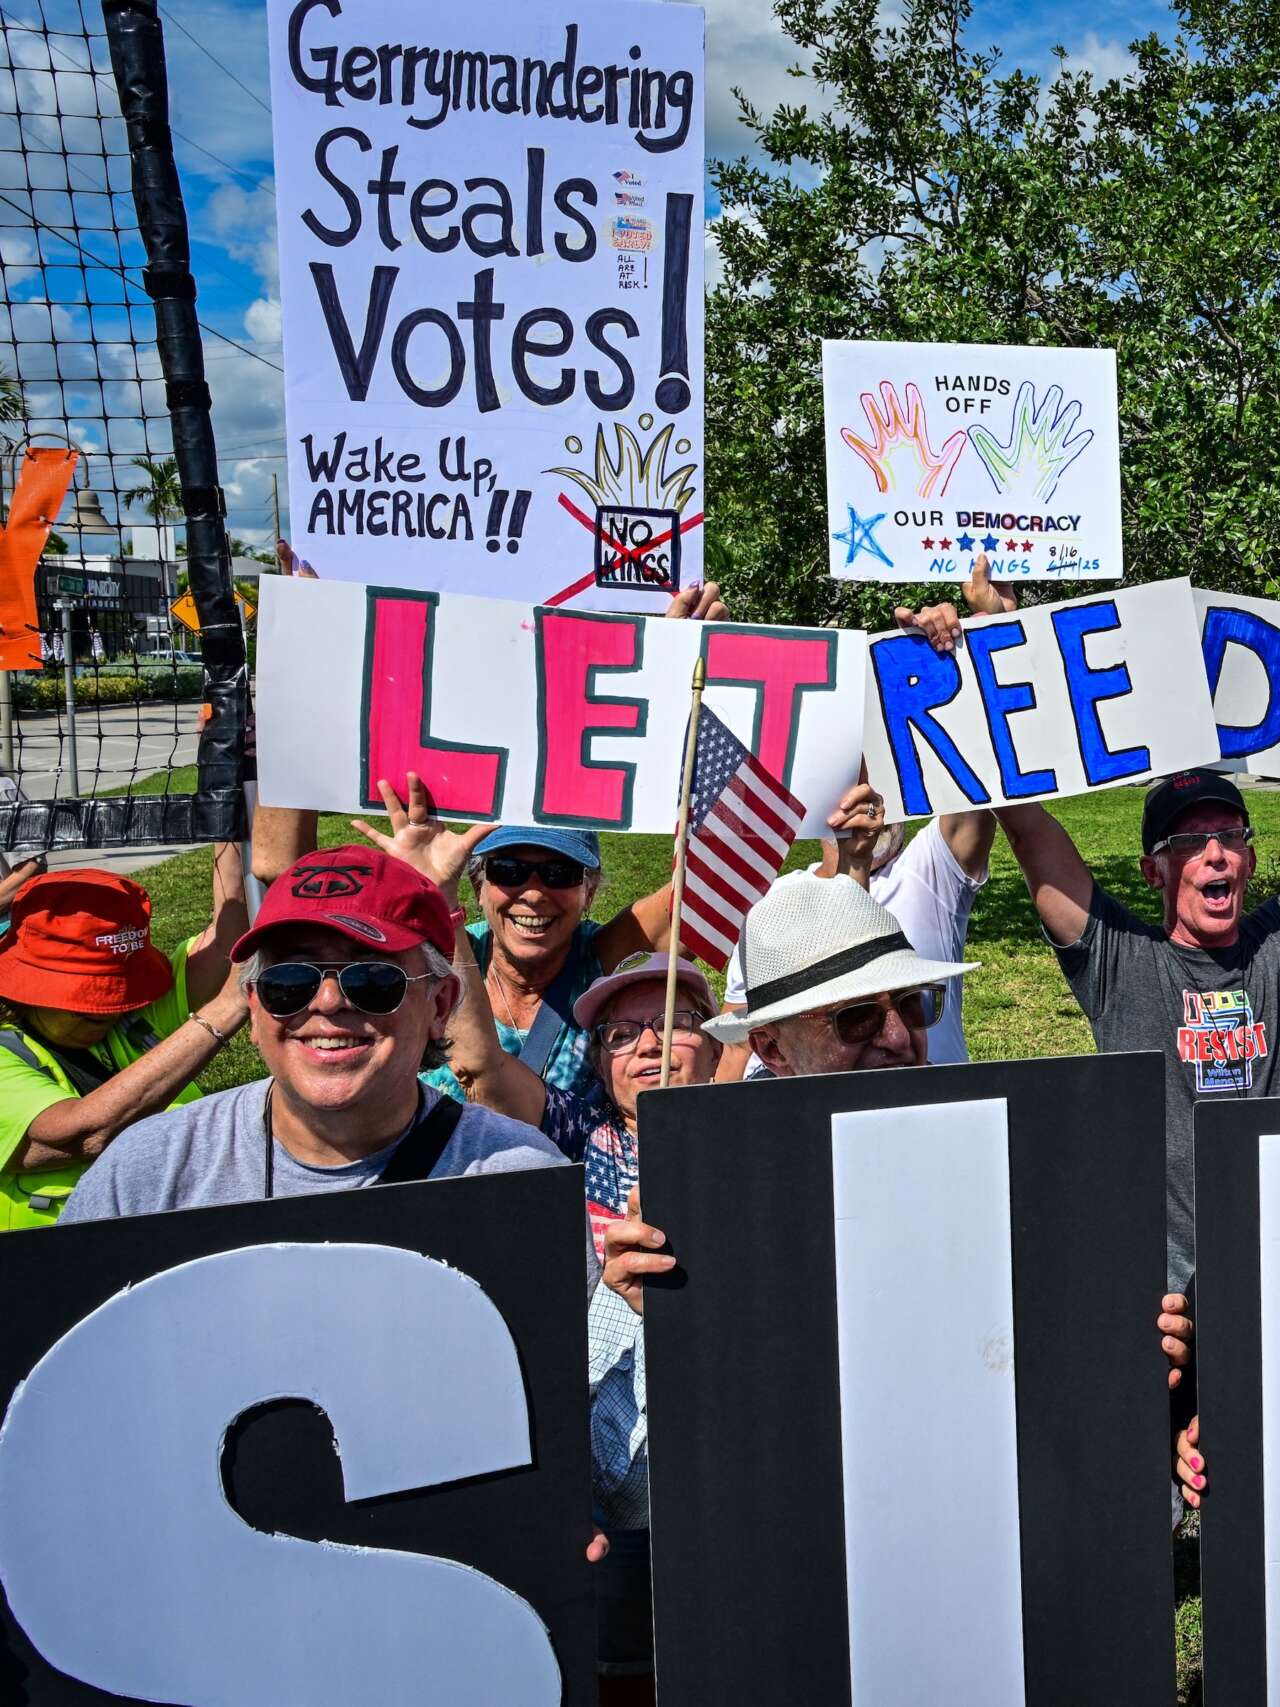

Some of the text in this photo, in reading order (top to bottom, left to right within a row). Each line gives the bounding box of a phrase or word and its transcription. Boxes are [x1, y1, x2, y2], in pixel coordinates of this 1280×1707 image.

[288, 0, 694, 153] Gerrymandering
[301, 127, 598, 263] Steals
[617, 254, 635, 263] ALL
[618, 264, 636, 272] ARE
[619, 272, 633, 280] AT
[935, 375, 1011, 396] HANDS
[945, 397, 992, 415] OFF
[301, 432, 497, 497] Wake Up,
[609, 516, 653, 548] NO
[894, 511, 1081, 532] OUR DEMOCRACY
[603, 550, 670, 584] KINGS
[929, 558, 957, 574] NO
[360, 586, 839, 829] LET
[110, 940, 145, 955] TO BE
[1177, 1022, 1268, 1063] RESIST
